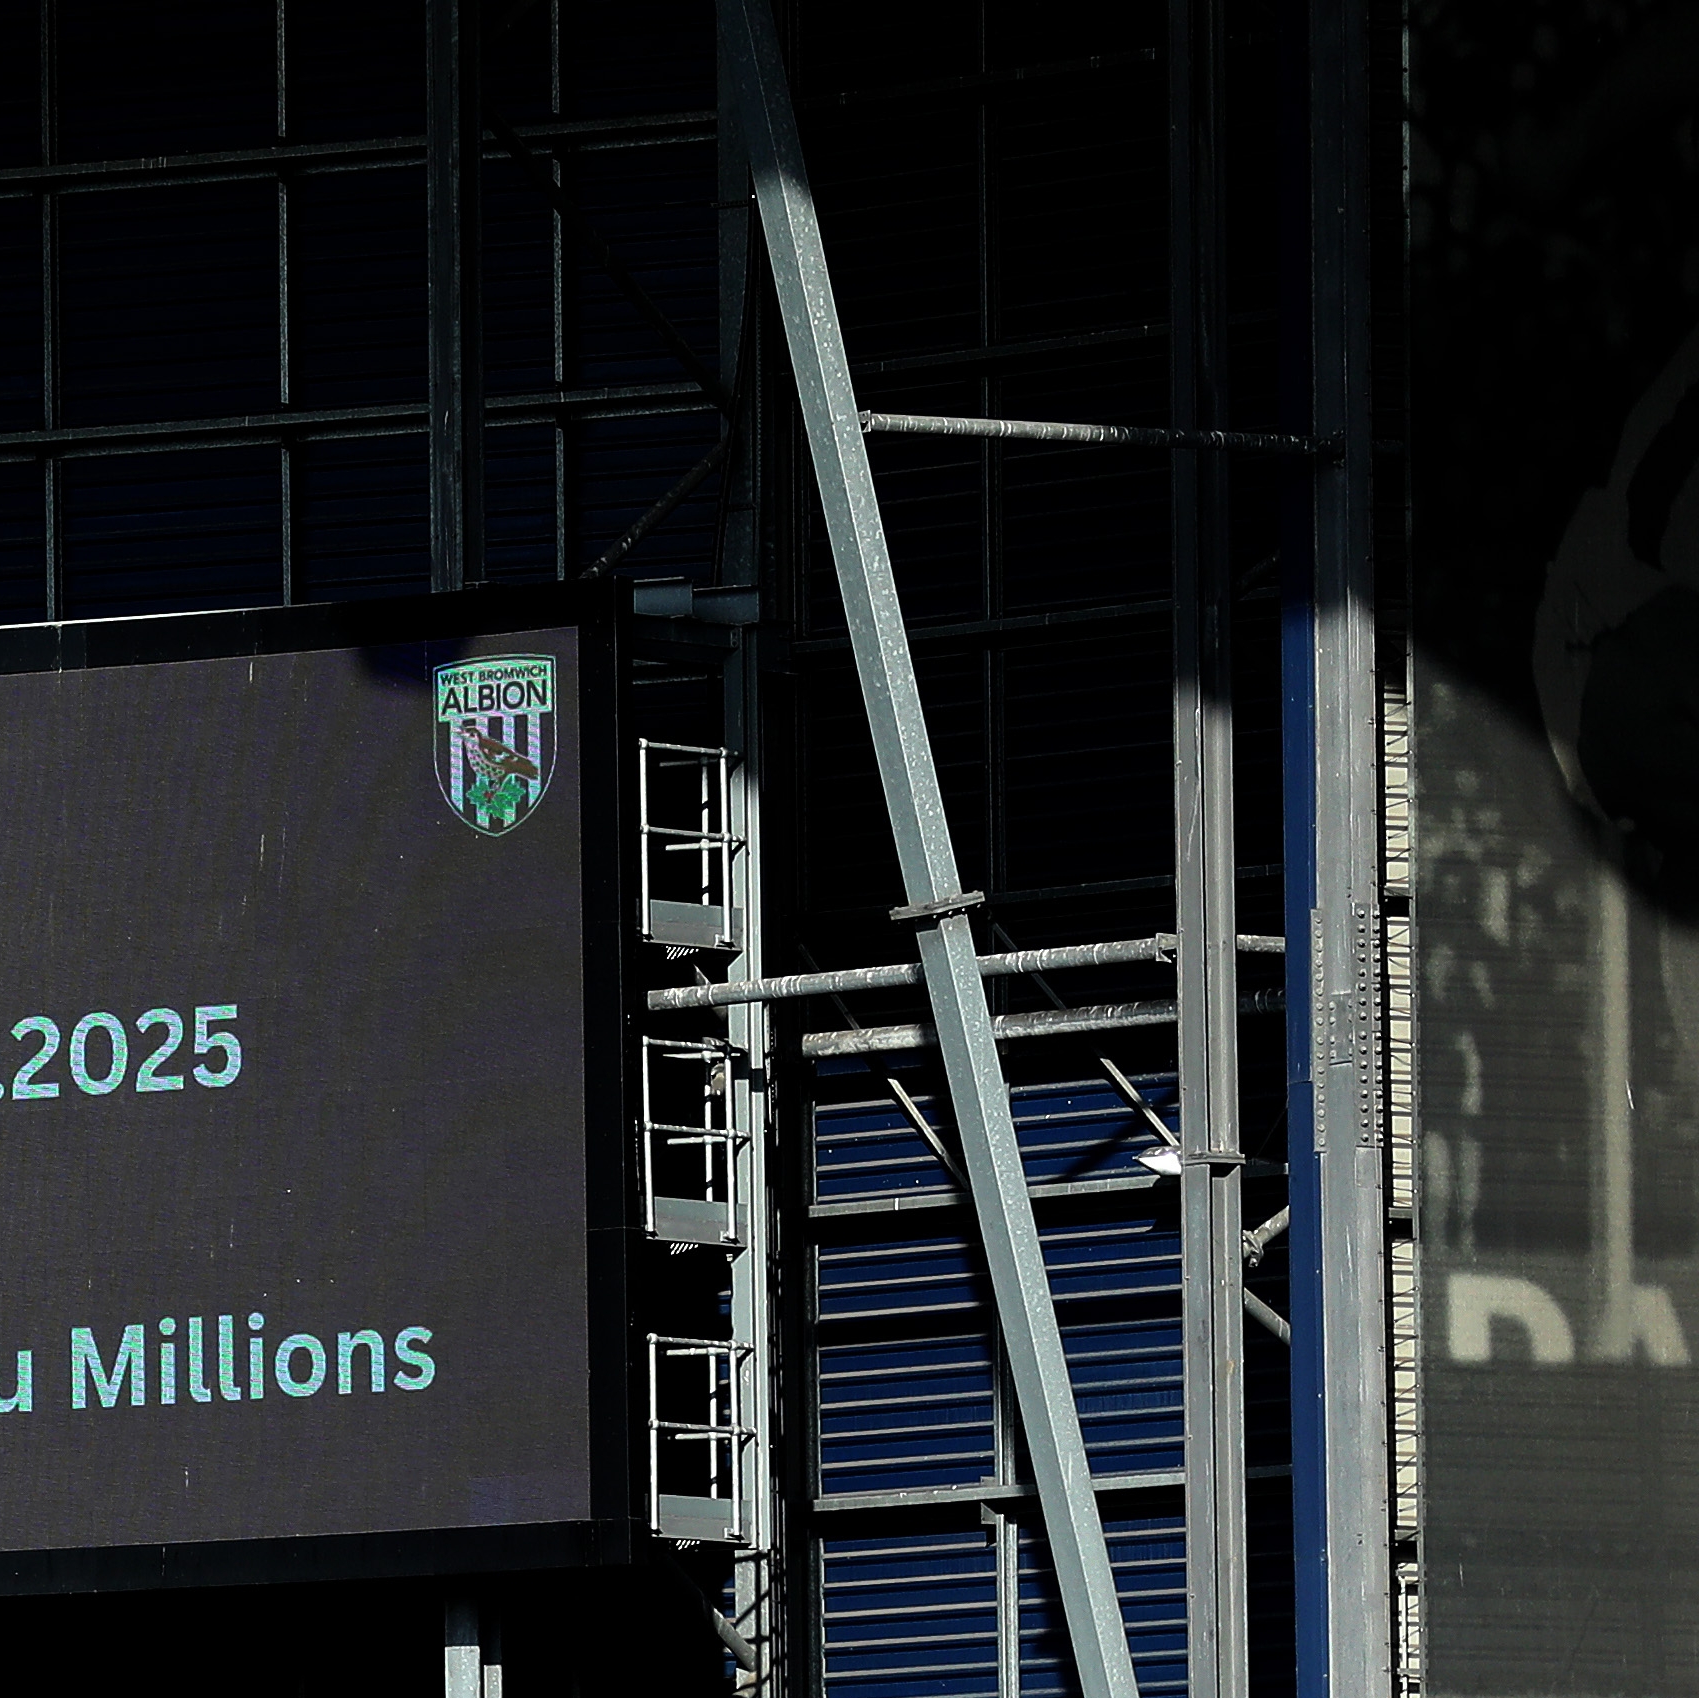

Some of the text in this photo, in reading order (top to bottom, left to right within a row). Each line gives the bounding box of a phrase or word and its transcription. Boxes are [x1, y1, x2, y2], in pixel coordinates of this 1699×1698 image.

[441, 665, 547, 686] WEST BROMWICH
[441, 679, 547, 715] ALBION
[71, 1312, 436, 1410] Millions
